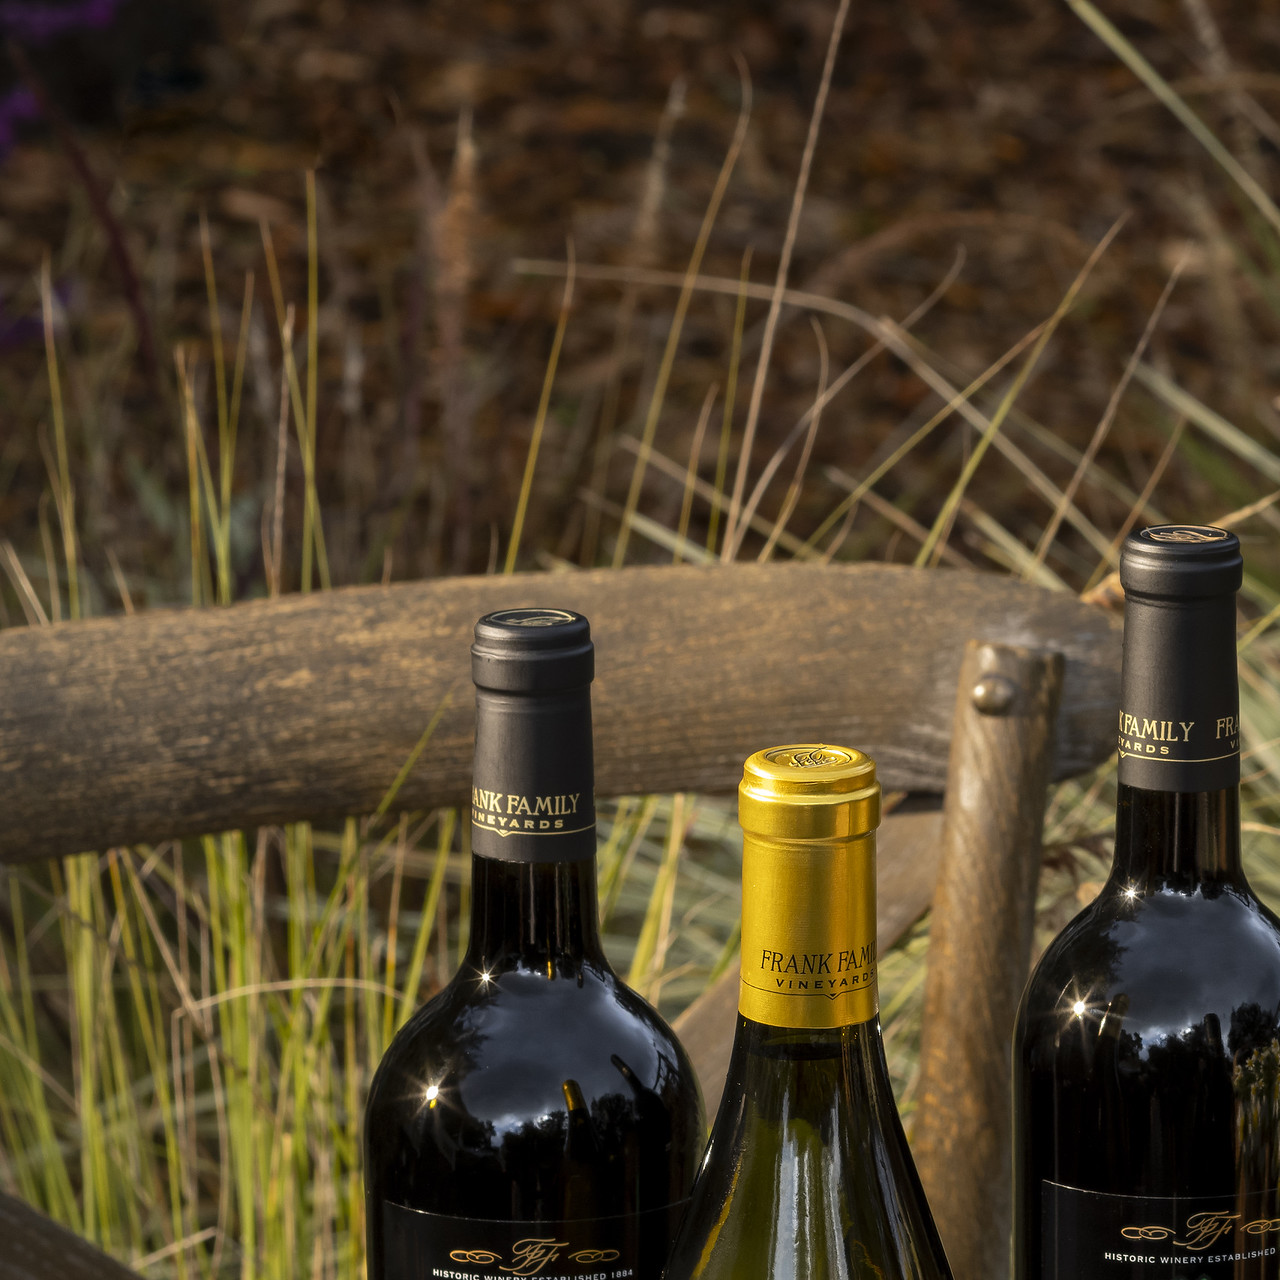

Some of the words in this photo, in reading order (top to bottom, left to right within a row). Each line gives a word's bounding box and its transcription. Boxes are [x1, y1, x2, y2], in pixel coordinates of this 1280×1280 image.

[1124, 713, 1195, 742] FAMILY
[472, 785, 503, 813] ANK
[506, 793, 580, 816] FAMILY
[760, 949, 833, 975] FRANK
[1104, 1252, 1156, 1264] HISTORIC
[1160, 1256, 1203, 1264] WINERY
[1207, 1246, 1276, 1263] ESTABLISHED
[611, 1269, 634, 1279] 1884
